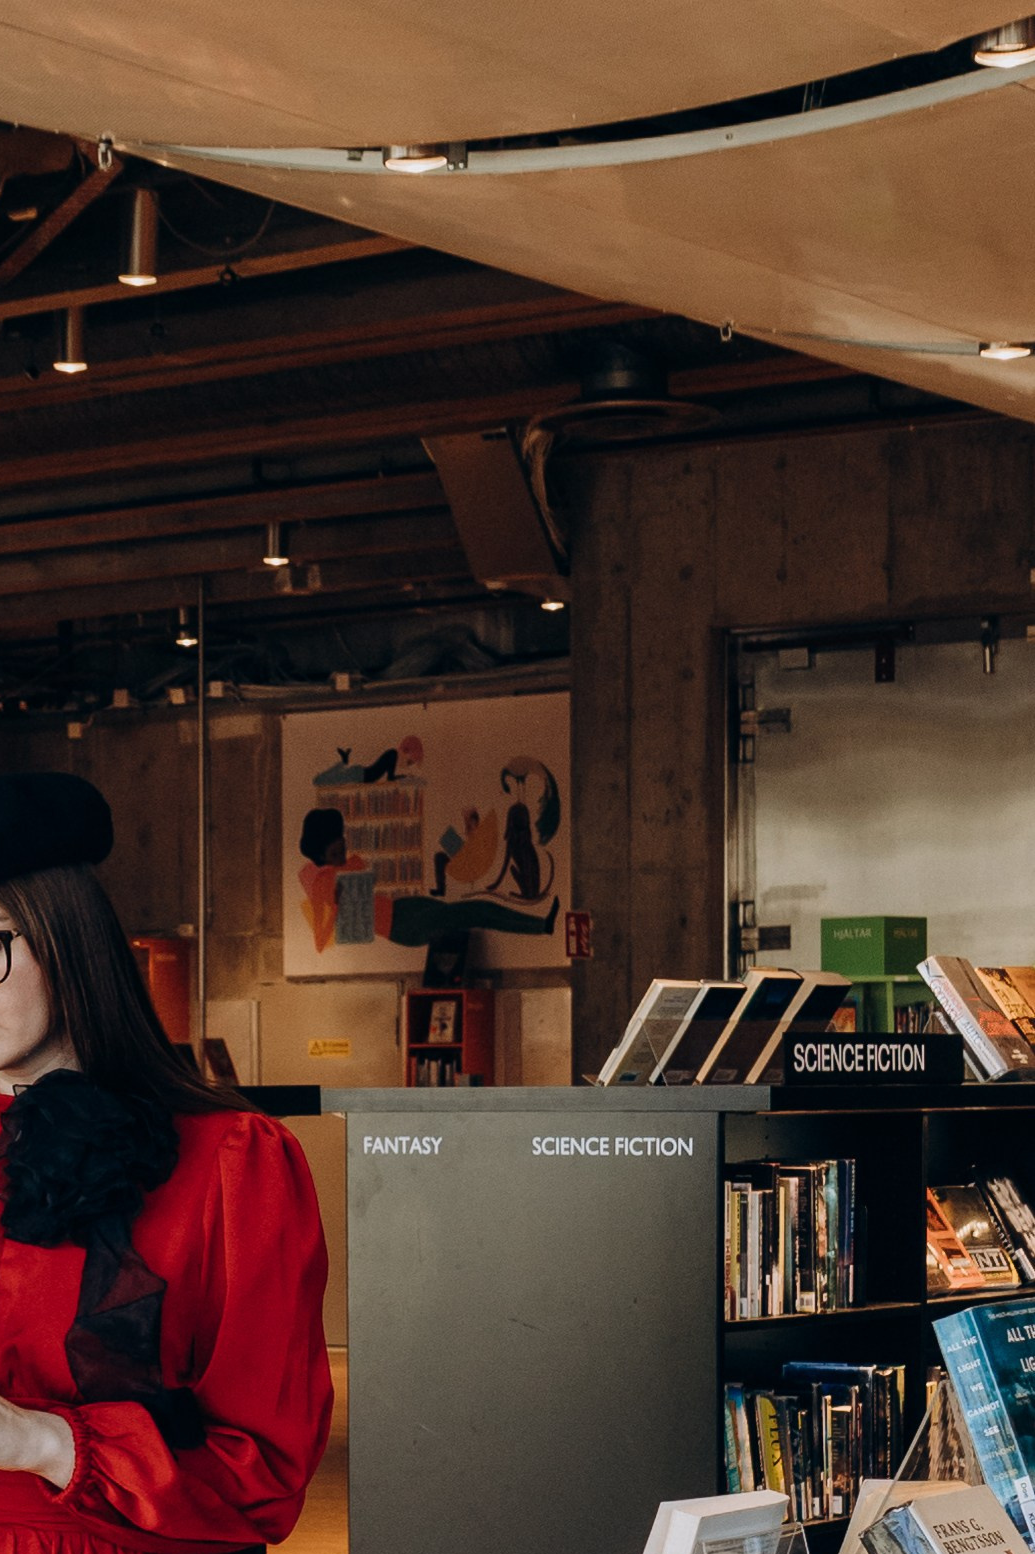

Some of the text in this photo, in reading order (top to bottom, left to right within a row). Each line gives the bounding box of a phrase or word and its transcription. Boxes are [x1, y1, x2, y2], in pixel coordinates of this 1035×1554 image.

[793, 1043, 925, 1072] SCIENCE FICTION
[364, 1136, 442, 1155] FANTASY
[532, 1136, 693, 1156] SCIENCE FICTION
[1007, 1324, 1035, 1343] ALL TH
[946, 1335, 978, 1353] ALL THE
[957, 1359, 982, 1374] LIGHT
[1020, 1356, 1035, 1373] LIG
[970, 1382, 985, 1393] WE
[967, 1400, 1000, 1418] CANNOT
[983, 1425, 1000, 1437] SEE
[933, 1518, 984, 1540] FRANS G.
